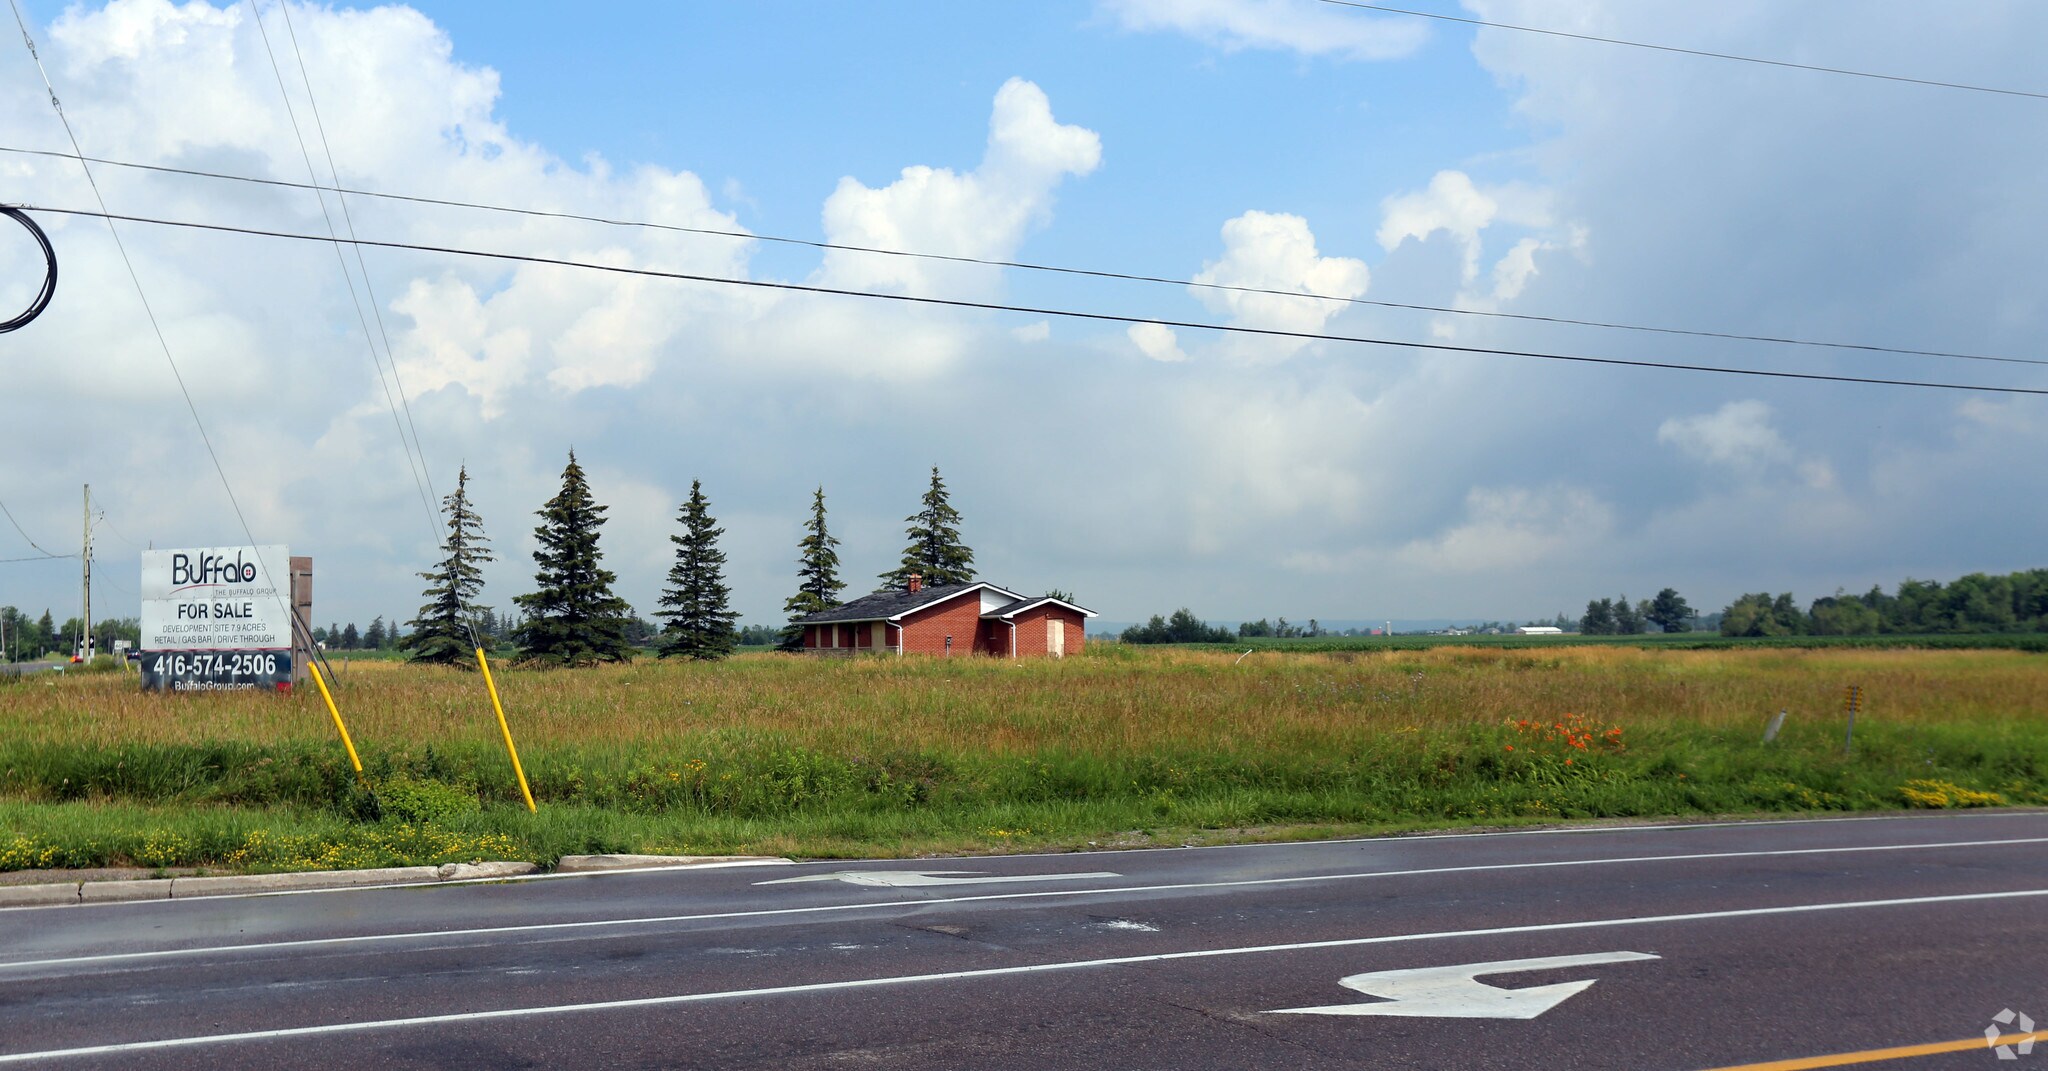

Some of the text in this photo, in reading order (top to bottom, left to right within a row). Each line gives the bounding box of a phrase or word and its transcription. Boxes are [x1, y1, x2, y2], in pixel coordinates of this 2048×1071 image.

[173, 550, 256, 585] Buffalo
[178, 603, 252, 619] FOR SALE
[163, 624, 212, 633] DEVELOPMENT
[215, 624, 229, 632] SITE
[242, 623, 266, 631] ACRES
[155, 636, 176, 644] RETAIL
[218, 635, 238, 643] DRIVE
[154, 655, 276, 676] 416-574-2506
